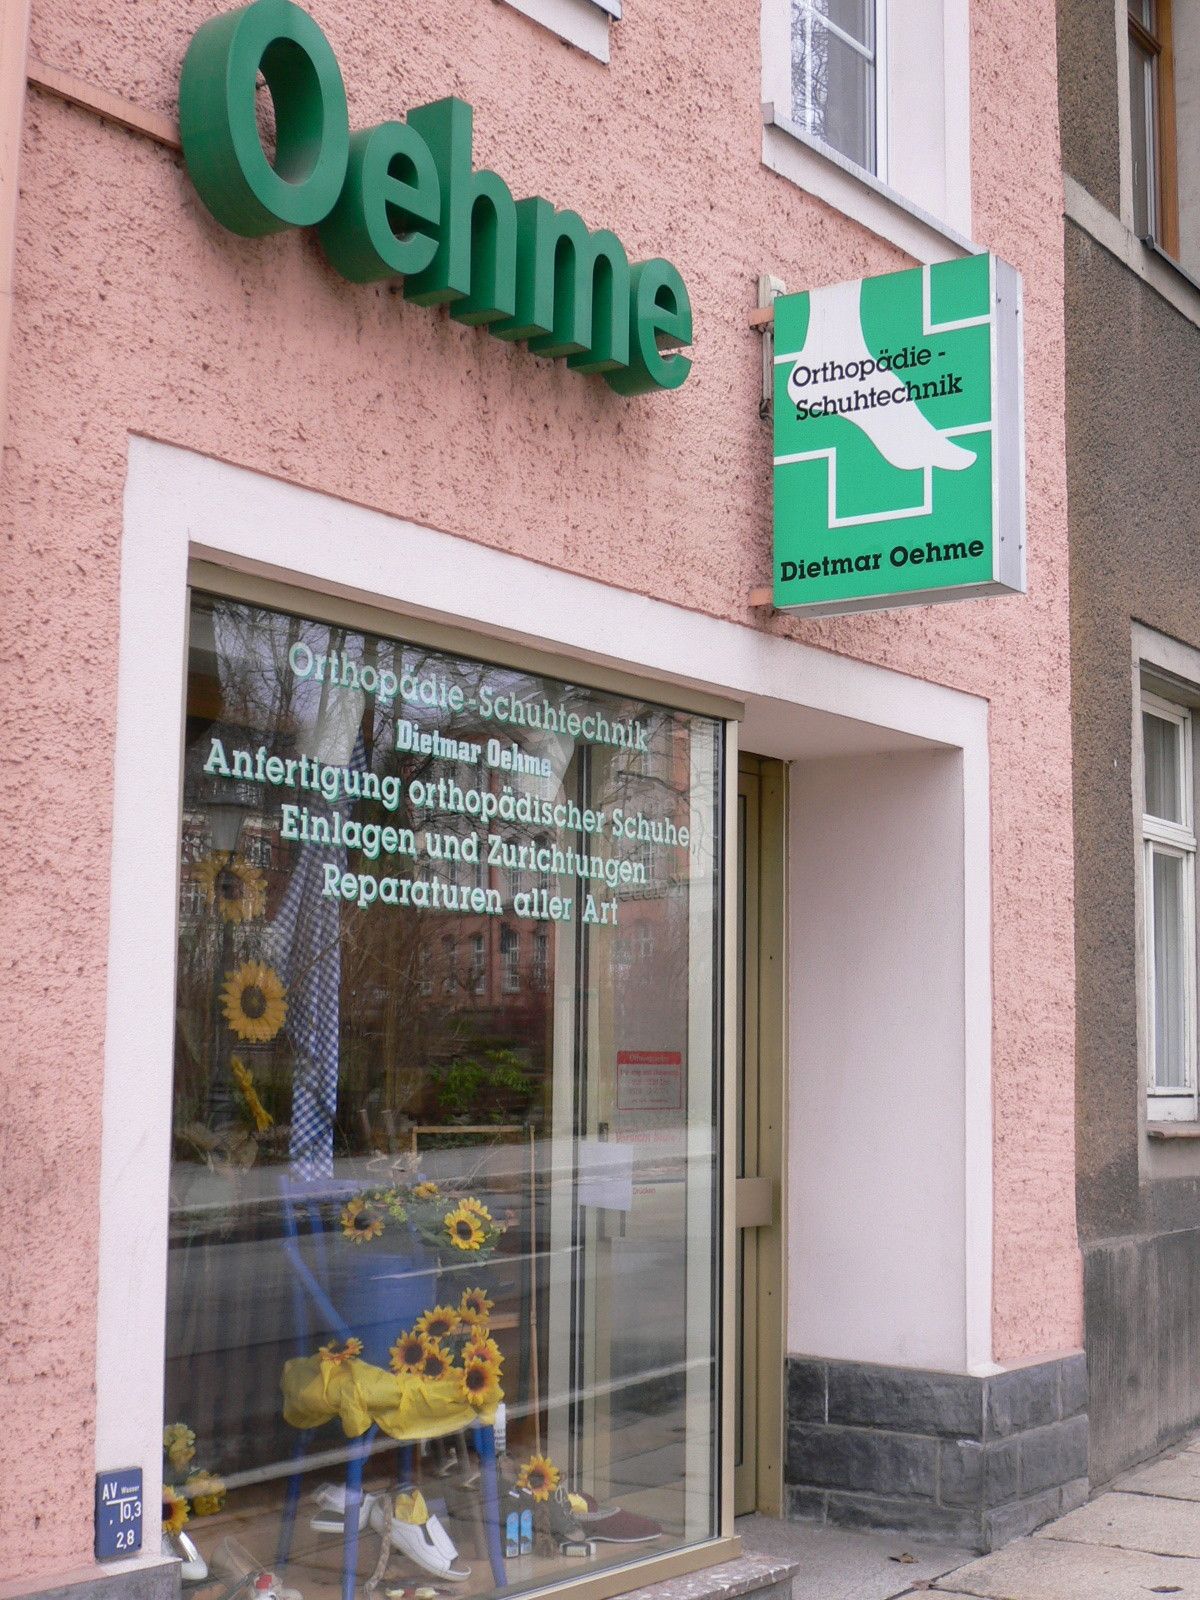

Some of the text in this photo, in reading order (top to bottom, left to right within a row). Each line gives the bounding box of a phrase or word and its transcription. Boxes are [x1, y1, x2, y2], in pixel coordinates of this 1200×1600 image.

[179, 0, 693, 396] Oehme
[796, 373, 963, 421] Schuhtechnik
[780, 539, 985, 582] Dietmar Oehme
[395, 719, 551, 778] Dietmar Oehme
[203, 738, 402, 812] Anfertigung
[408, 776, 605, 834] orthopädischer
[281, 804, 648, 889] Einlagen und Zurichtungen
[321, 863, 619, 927] Reparaturen aller Art
[102, 1482, 118, 1500] AV
[116, 1529, 135, 1549] 2,8
